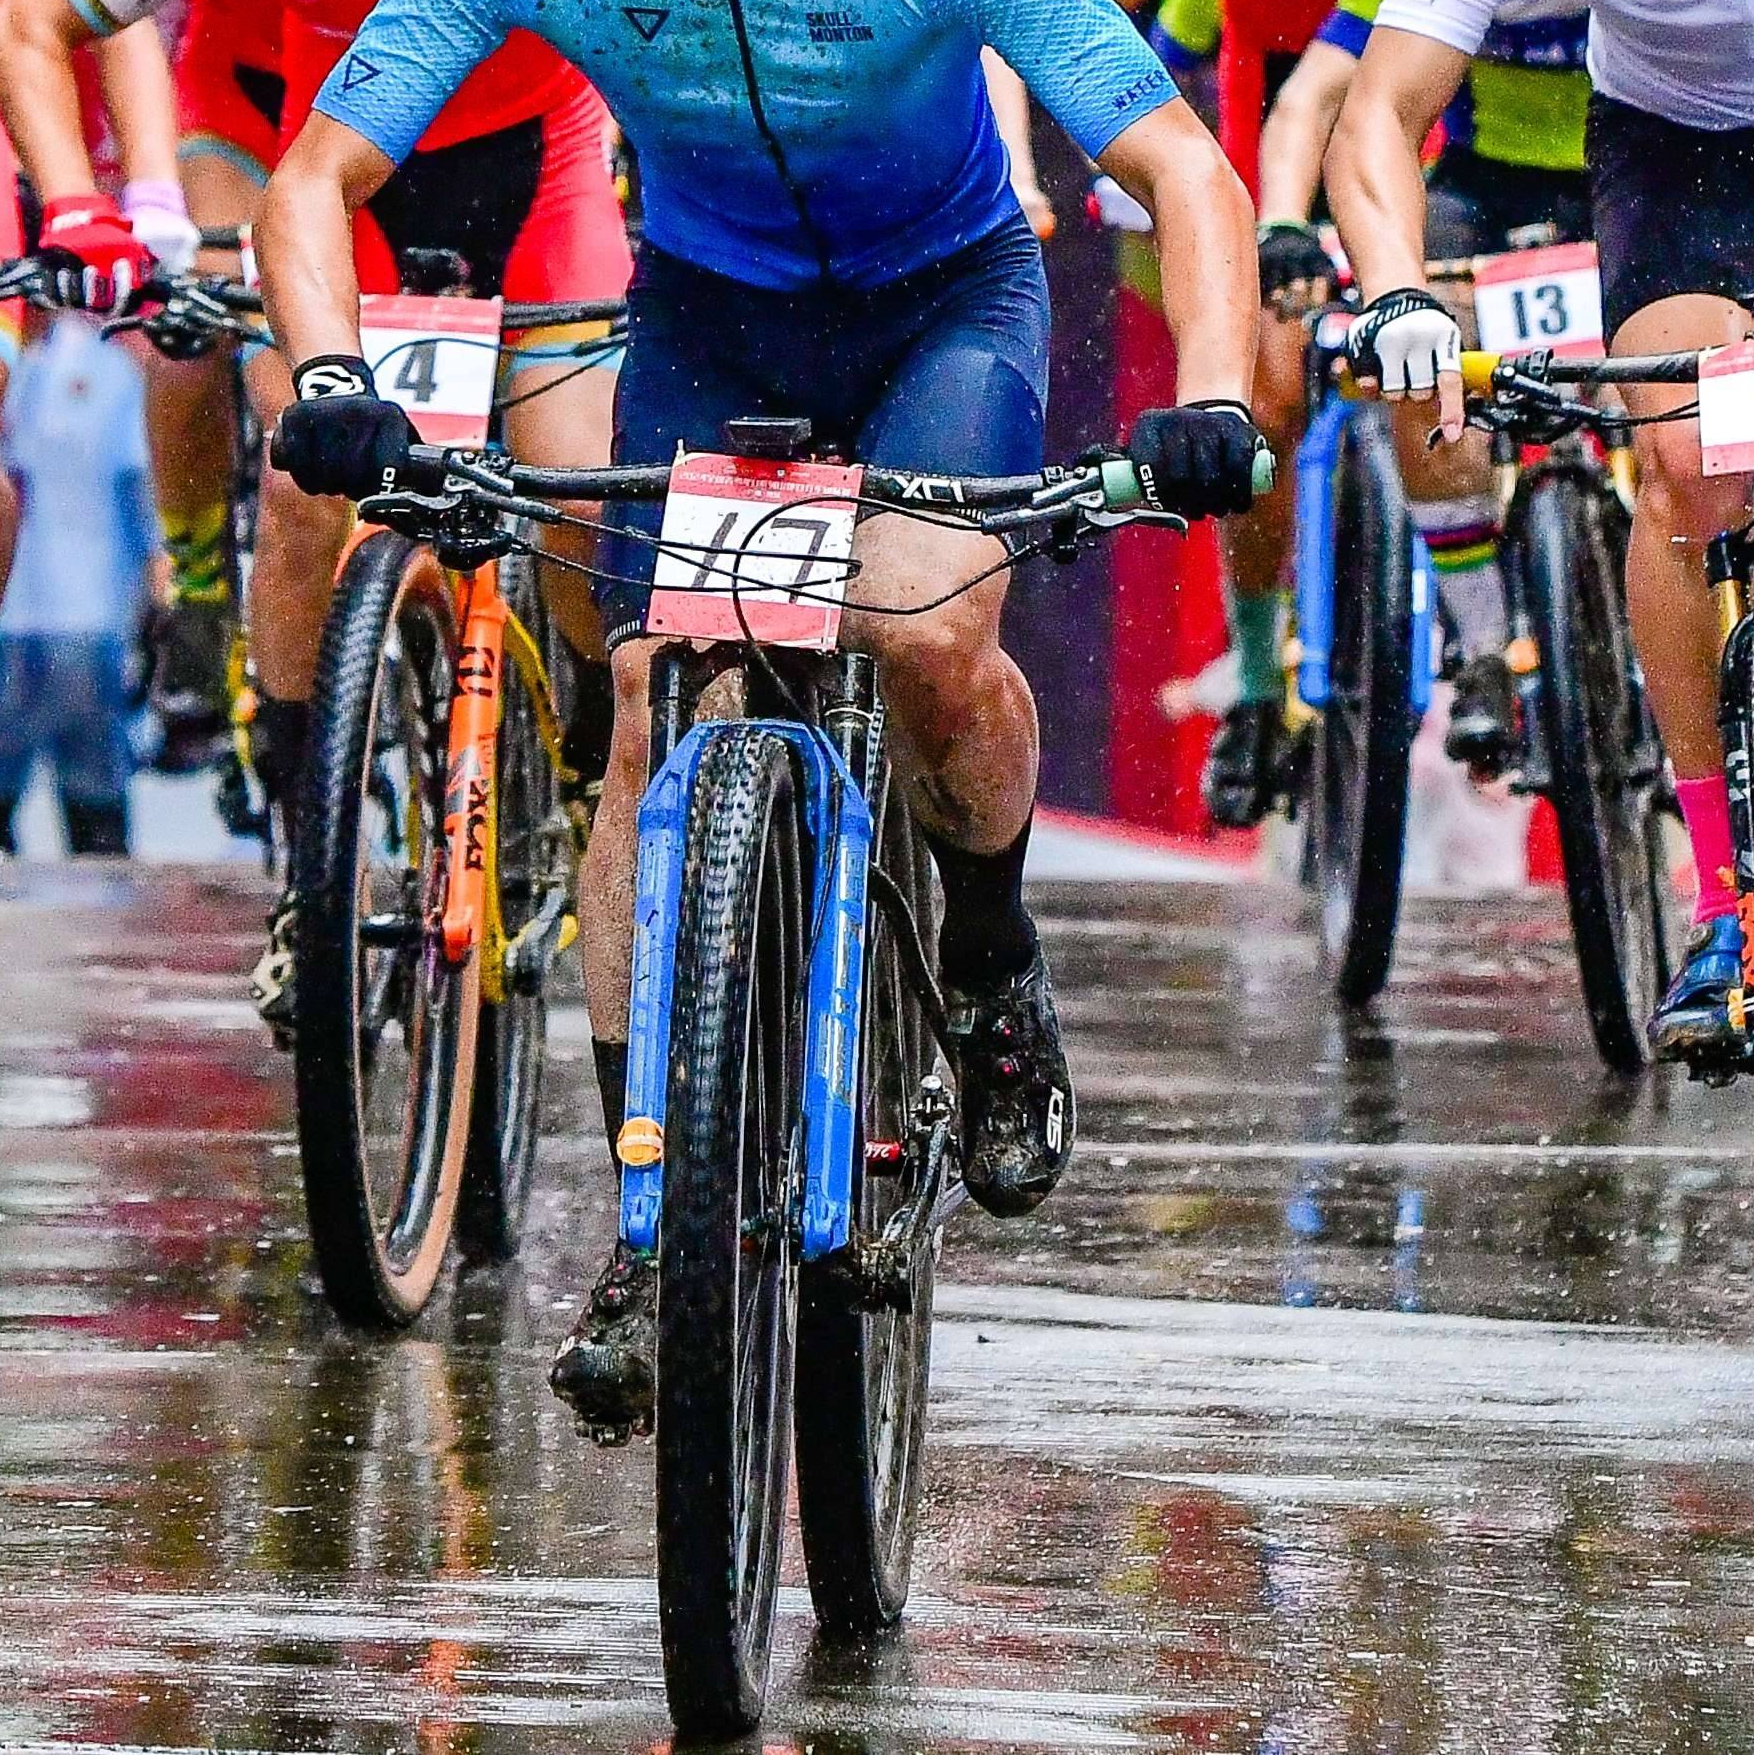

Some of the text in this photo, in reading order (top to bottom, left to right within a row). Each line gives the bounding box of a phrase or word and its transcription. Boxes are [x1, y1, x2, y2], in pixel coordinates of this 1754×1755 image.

[808, 25, 875, 43] MONTON
[1510, 283, 1568, 340] 13
[393, 339, 438, 404] 4
[691, 511, 832, 605] 17
